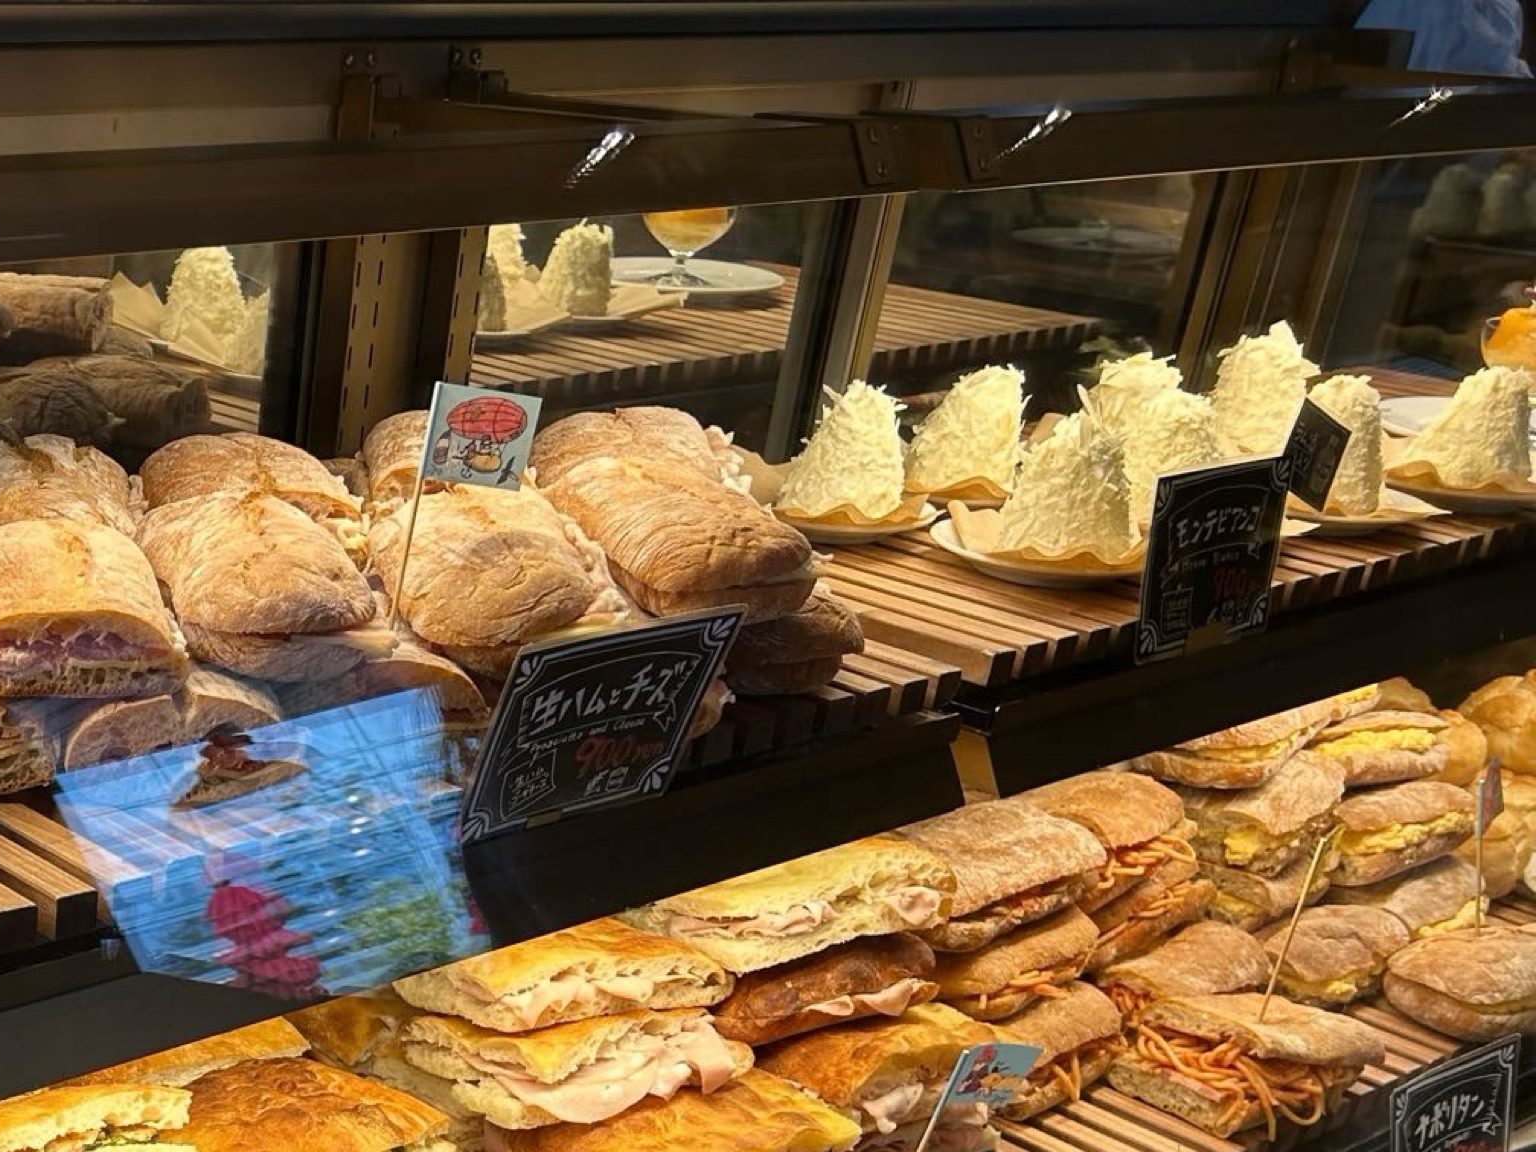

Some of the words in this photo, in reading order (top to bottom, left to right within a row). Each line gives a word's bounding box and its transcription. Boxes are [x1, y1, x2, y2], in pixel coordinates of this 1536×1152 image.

[529, 661, 687, 735] 生ハムとチーズ
[1413, 1094, 1485, 1150] ナポリタン
